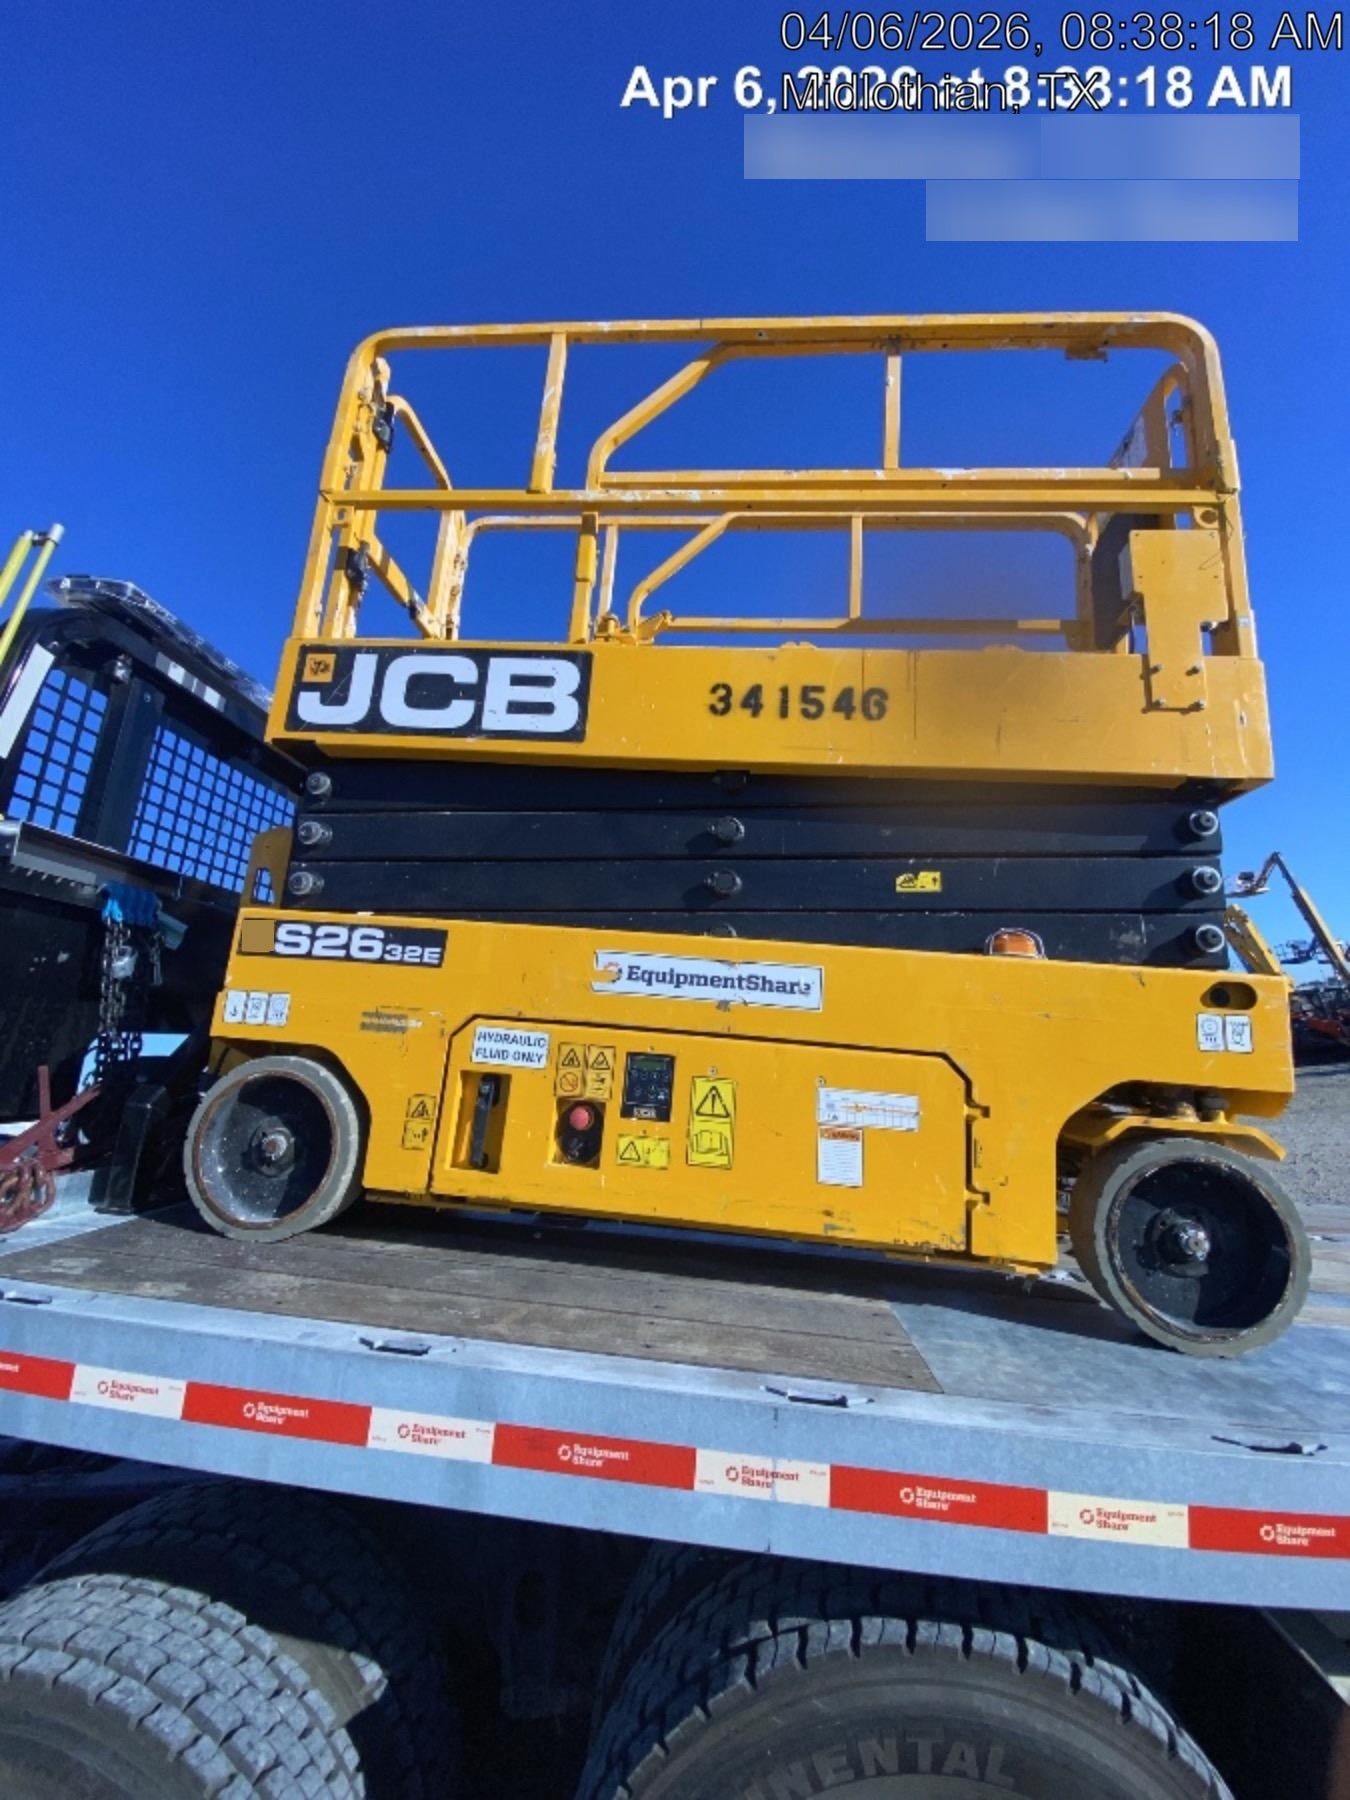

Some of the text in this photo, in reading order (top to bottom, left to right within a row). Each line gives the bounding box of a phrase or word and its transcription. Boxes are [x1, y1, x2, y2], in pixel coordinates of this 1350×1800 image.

[297, 652, 583, 733] JCB
[707, 683, 889, 722] 341546
[274, 922, 442, 965] S26 32E
[475, 1047, 544, 1064] FLUID ONLY
[477, 1031, 546, 1049] HYDRAULIC
